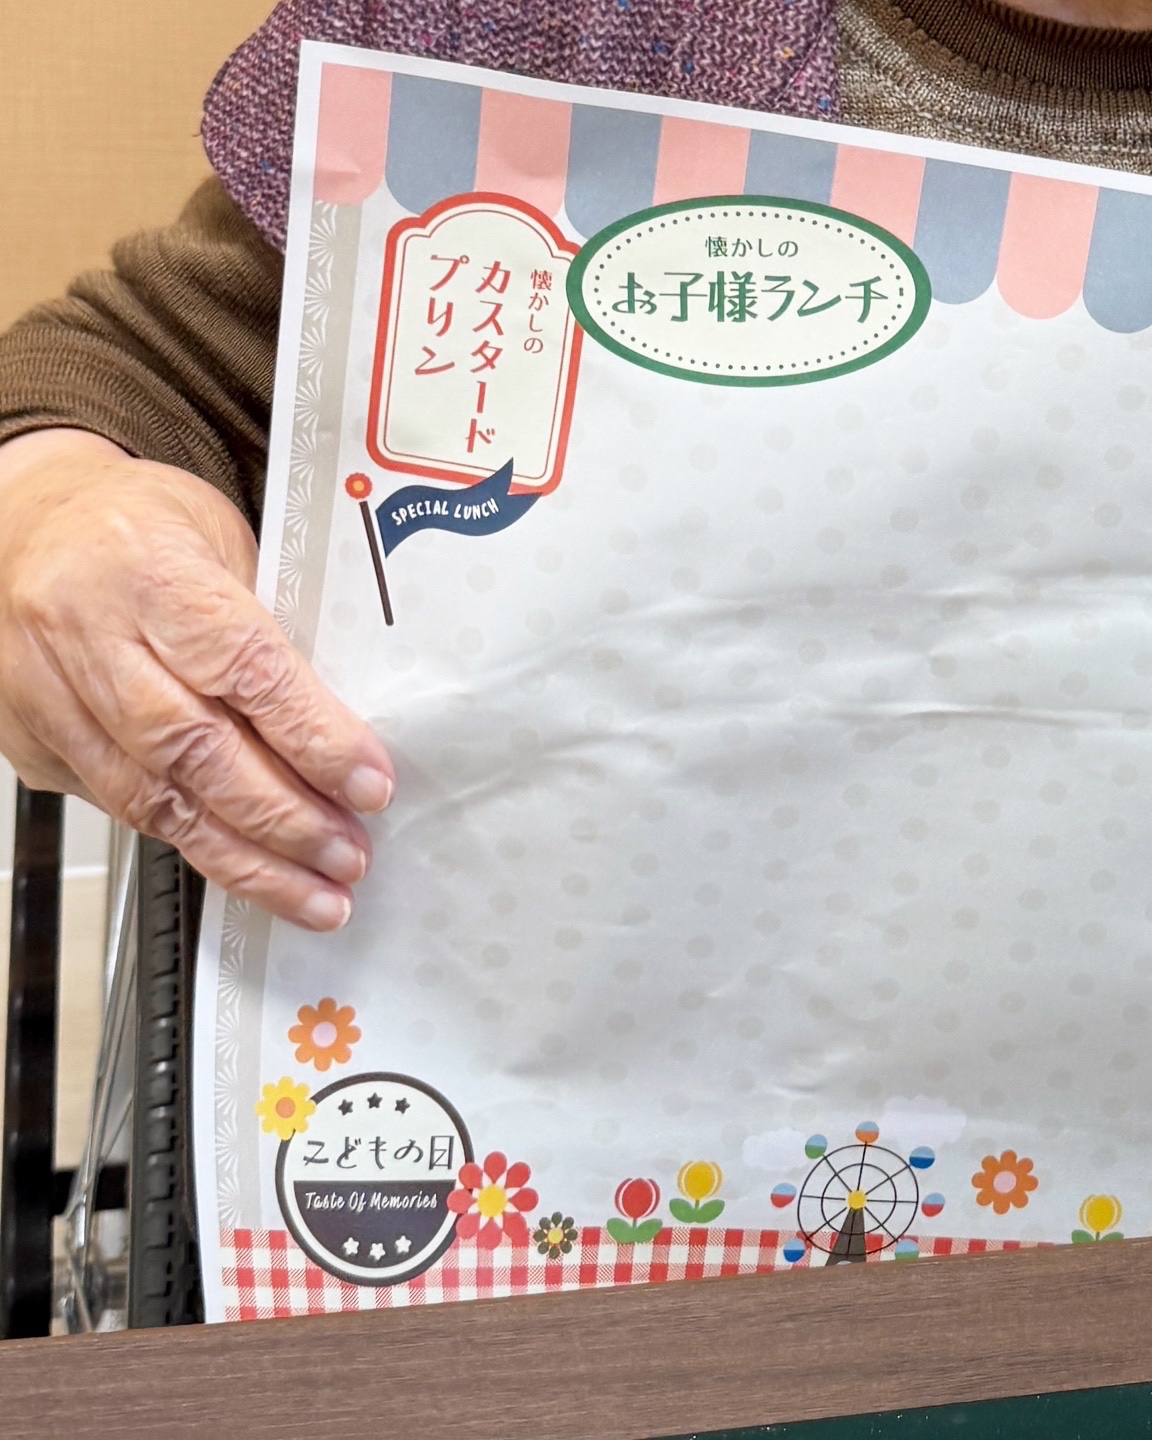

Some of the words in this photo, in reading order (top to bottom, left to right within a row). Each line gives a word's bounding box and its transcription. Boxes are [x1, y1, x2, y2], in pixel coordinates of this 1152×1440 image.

[704, 235, 799, 258] 懐かしの
[414, 254, 469, 376] プリン
[523, 268, 553, 354] 懐かしの
[611, 270, 889, 324] お子様ランチ
[466, 260, 511, 453] カスタード
[391, 500, 449, 526] SPECIAL
[453, 497, 499, 520] LUNCH
[303, 1135, 454, 1170] こどもの日
[305, 1192, 345, 1209] Taste
[349, 1191, 366, 1213] Of
[370, 1191, 437, 1211] Memories
